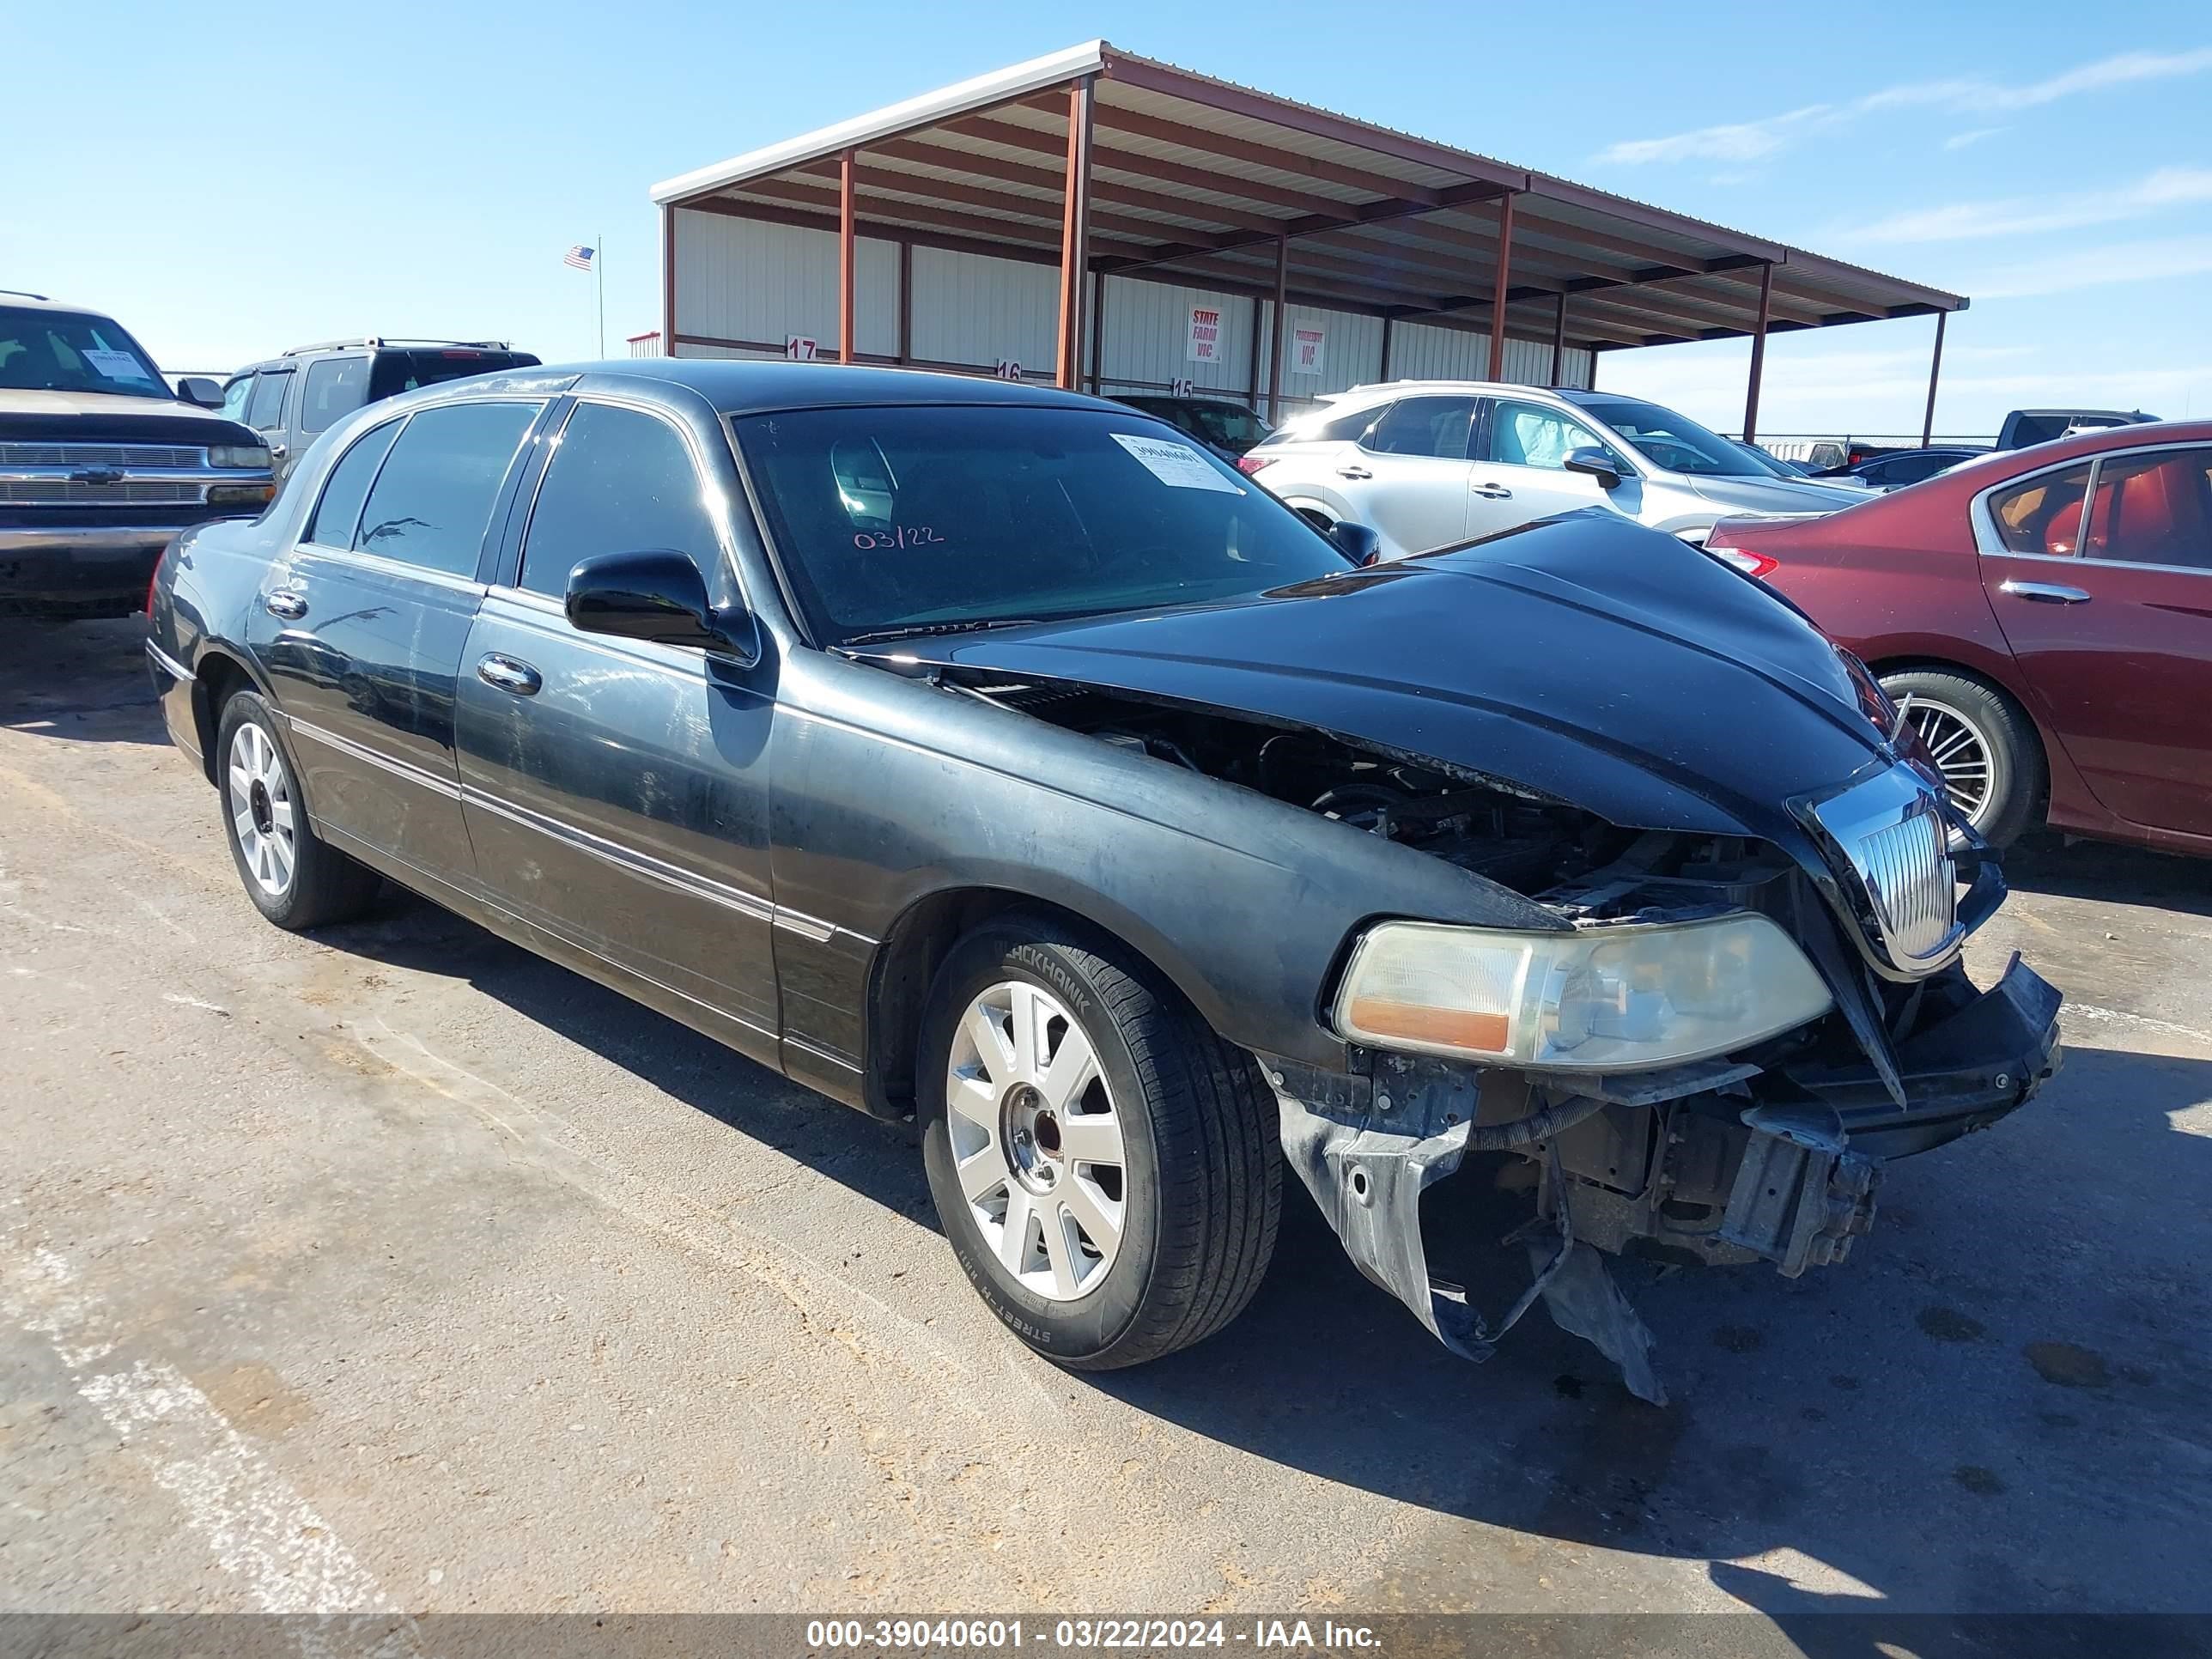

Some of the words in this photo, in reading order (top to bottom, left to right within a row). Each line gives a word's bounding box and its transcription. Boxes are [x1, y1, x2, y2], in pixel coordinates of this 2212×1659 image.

[1193, 310, 1219, 326] STATE
[1193, 326, 1218, 342] FARM
[789, 338, 816, 359] 17
[1197, 343, 1212, 358] VIC
[1302, 345, 1316, 366] VIC
[999, 362, 1021, 380] 16
[1175, 379, 1193, 398] 15
[854, 526, 945, 550] 03/22
